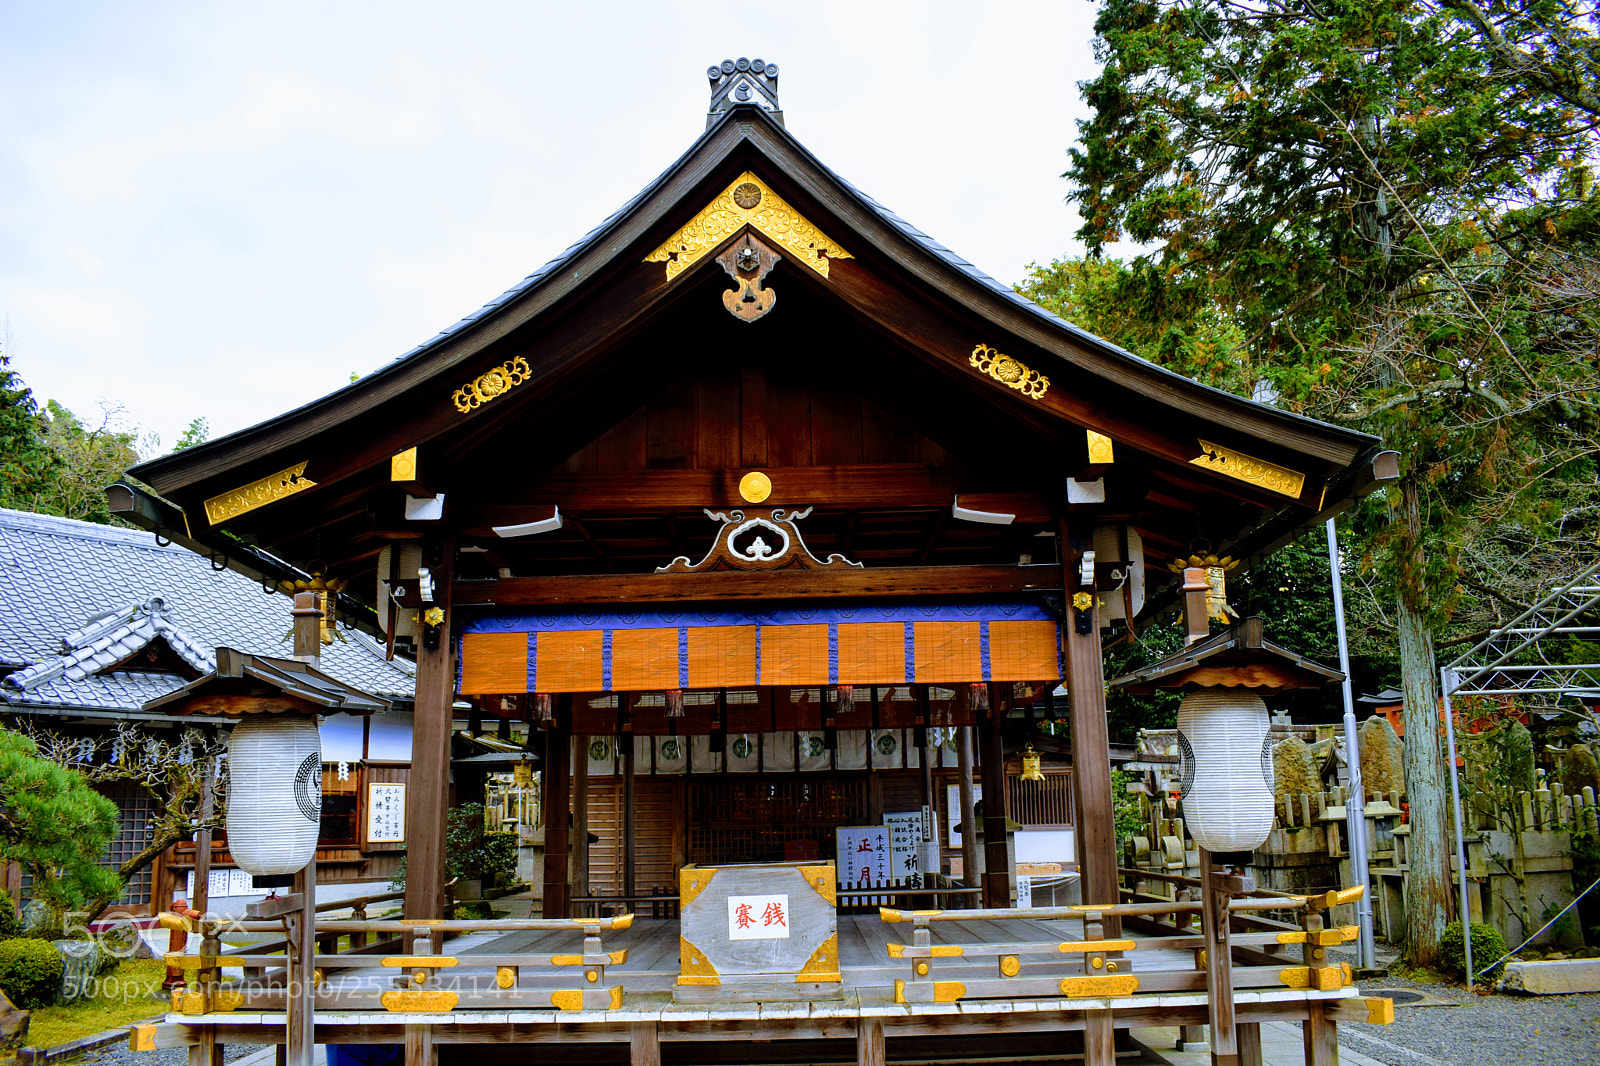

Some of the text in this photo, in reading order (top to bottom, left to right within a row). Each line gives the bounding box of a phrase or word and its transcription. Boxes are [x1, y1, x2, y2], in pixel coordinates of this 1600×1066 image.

[856, 838, 874, 882] 正月
[875, 834, 886, 880] 平成三十年
[735, 902, 786, 930] 賽銭
